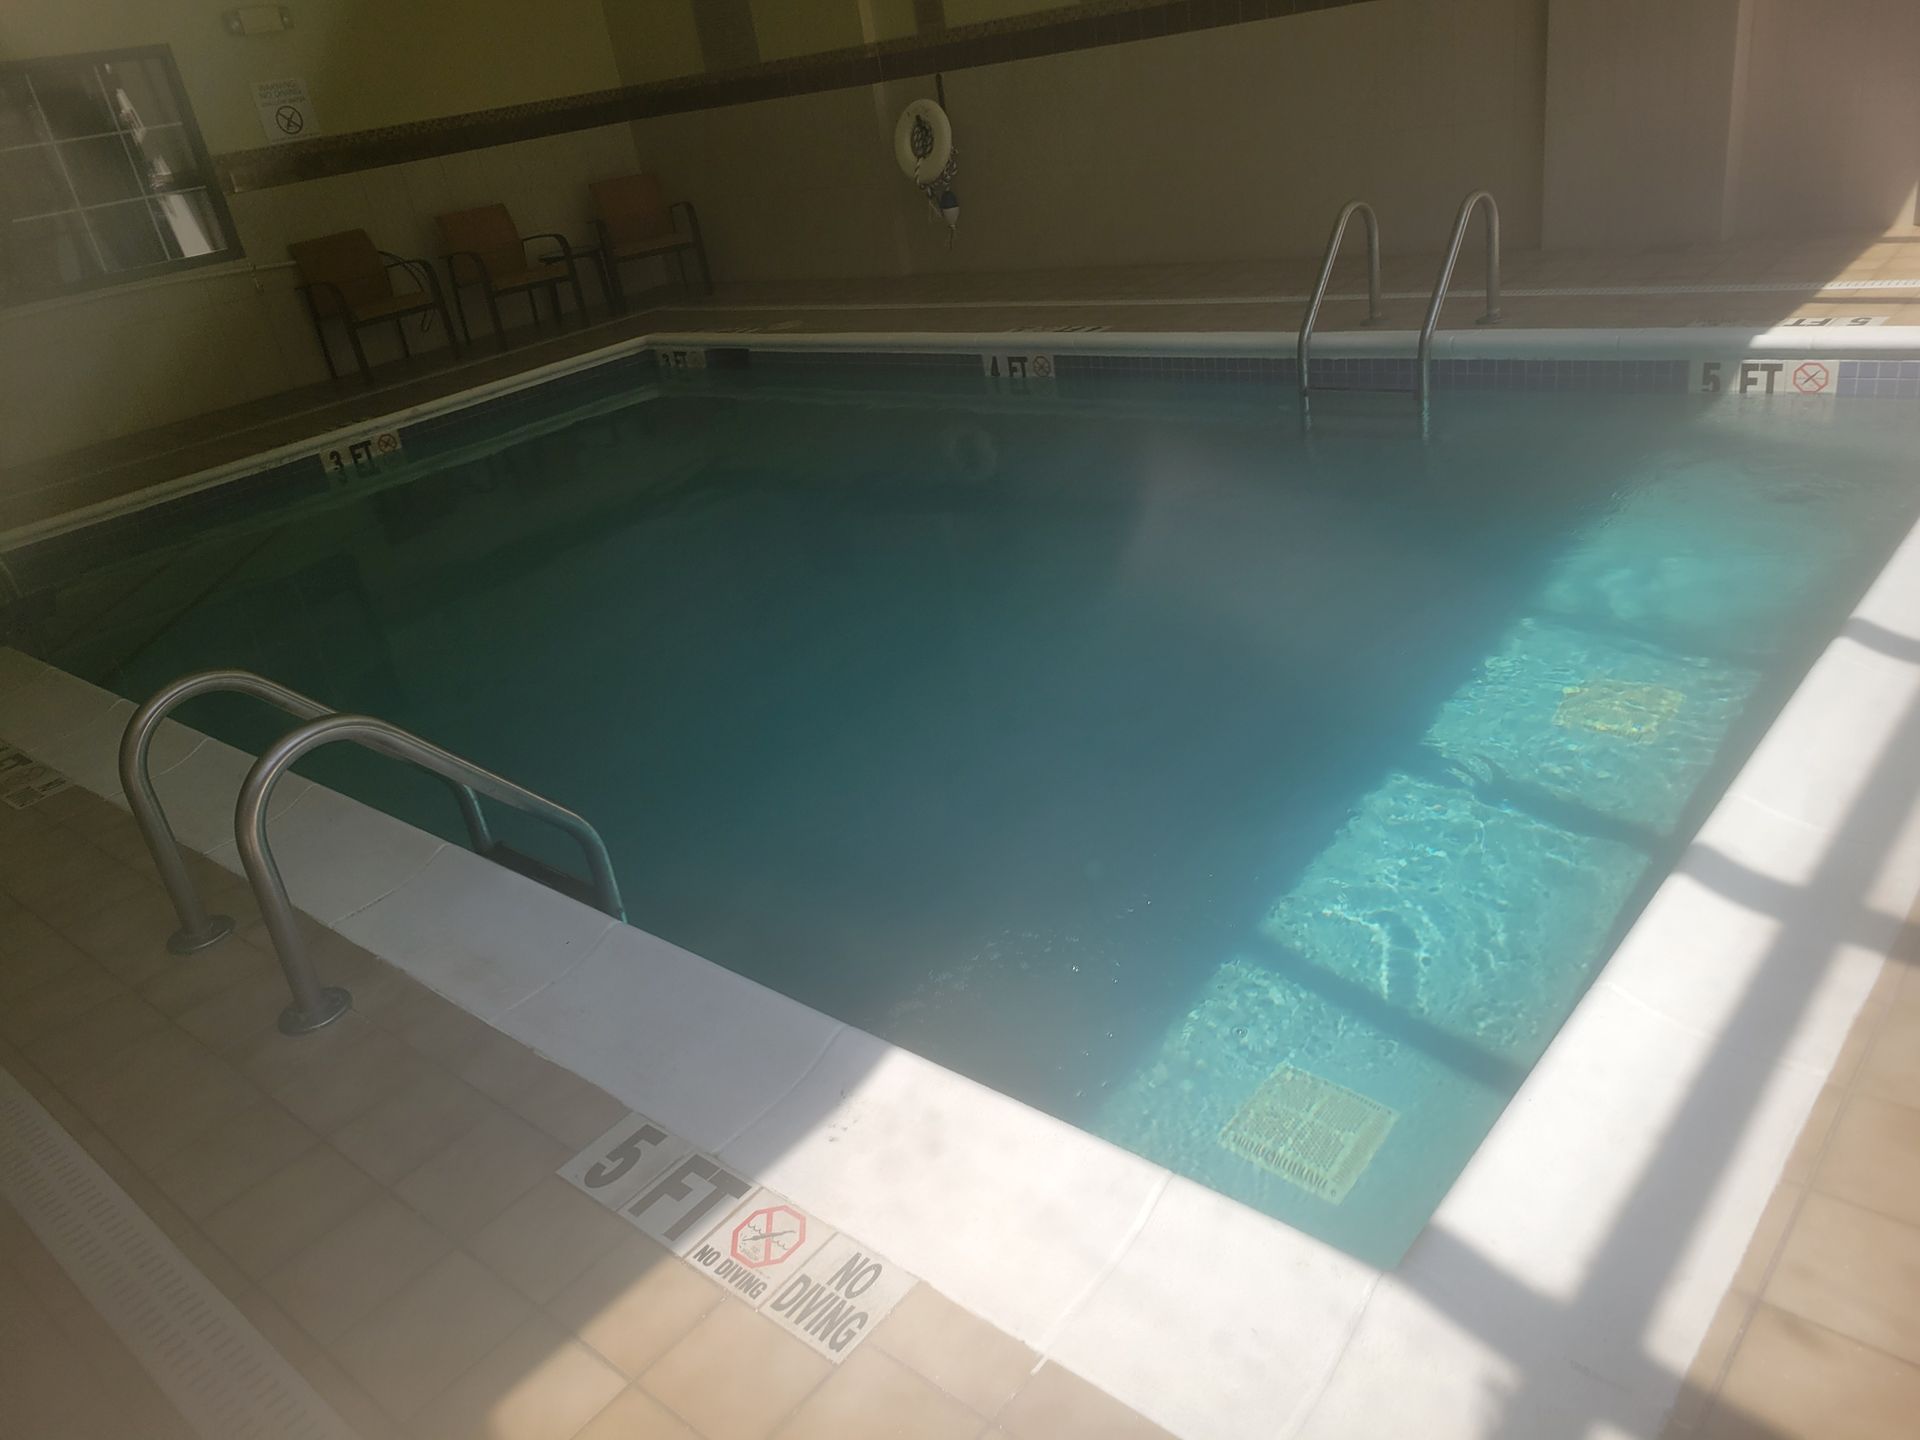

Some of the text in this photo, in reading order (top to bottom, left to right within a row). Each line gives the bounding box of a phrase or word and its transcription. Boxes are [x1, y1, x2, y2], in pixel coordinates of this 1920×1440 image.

[1006, 356, 1028, 378] FT
[1702, 362, 1784, 394] 5 FT
[329, 440, 372, 472] 3 FT
[584, 1124, 753, 1242] 5 FT
[693, 1244, 768, 1301] NO DIVING
[826, 1251, 883, 1300] NO
[770, 1274, 869, 1354] DIVING
